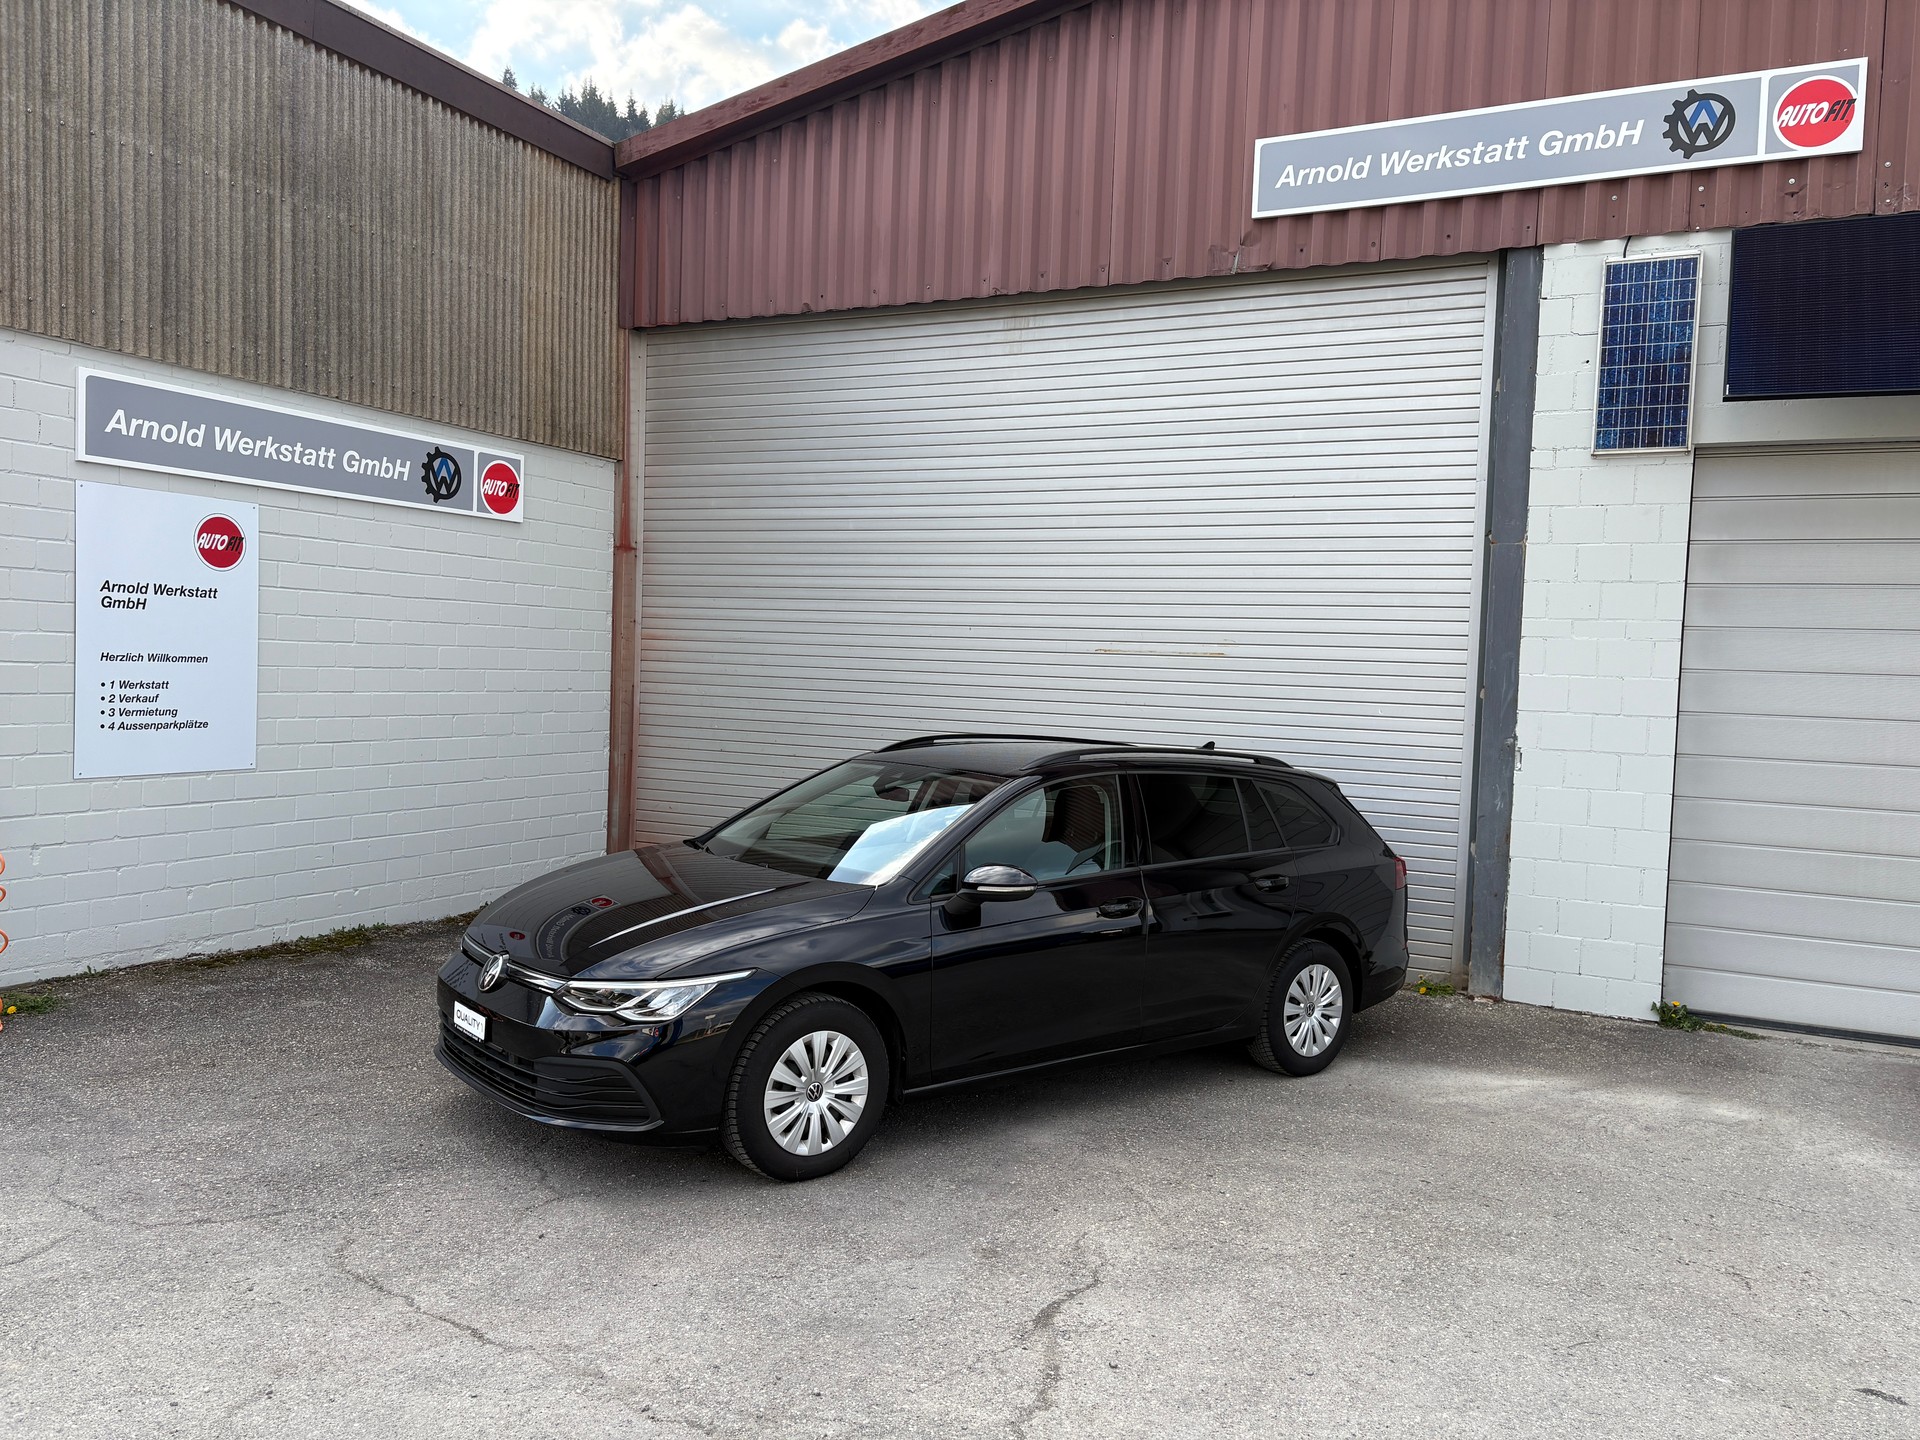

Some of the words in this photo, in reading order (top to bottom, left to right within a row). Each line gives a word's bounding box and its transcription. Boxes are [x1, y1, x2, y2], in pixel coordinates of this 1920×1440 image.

[1777, 98, 1857, 128] AUTOFIT
[1274, 154, 1371, 190] Arnold
[1380, 135, 1530, 176] Werkstatt
[1538, 119, 1646, 156] GmbH
[104, 408, 205, 448] Arnold
[214, 425, 337, 470] Werkstatt
[342, 450, 411, 482] GmbH
[482, 478, 520, 499] AUTOFIT
[198, 532, 244, 552] AUTOFIT
[100, 580, 149, 595] Arnold
[153, 583, 218, 599] Werkstatt
[101, 596, 147, 610] GmbH
[100, 652, 144, 663] Herzlich
[147, 653, 208, 664] Willkommen
[109, 680, 115, 690] 1
[118, 680, 169, 690] Werkstatt
[108, 694, 116, 703] 2
[118, 693, 159, 704] Verkauf
[108, 708, 115, 717] 3
[118, 707, 178, 718] Vermietung
[108, 721, 115, 731] 4
[117, 720, 209, 732] Aussenparkplätze
